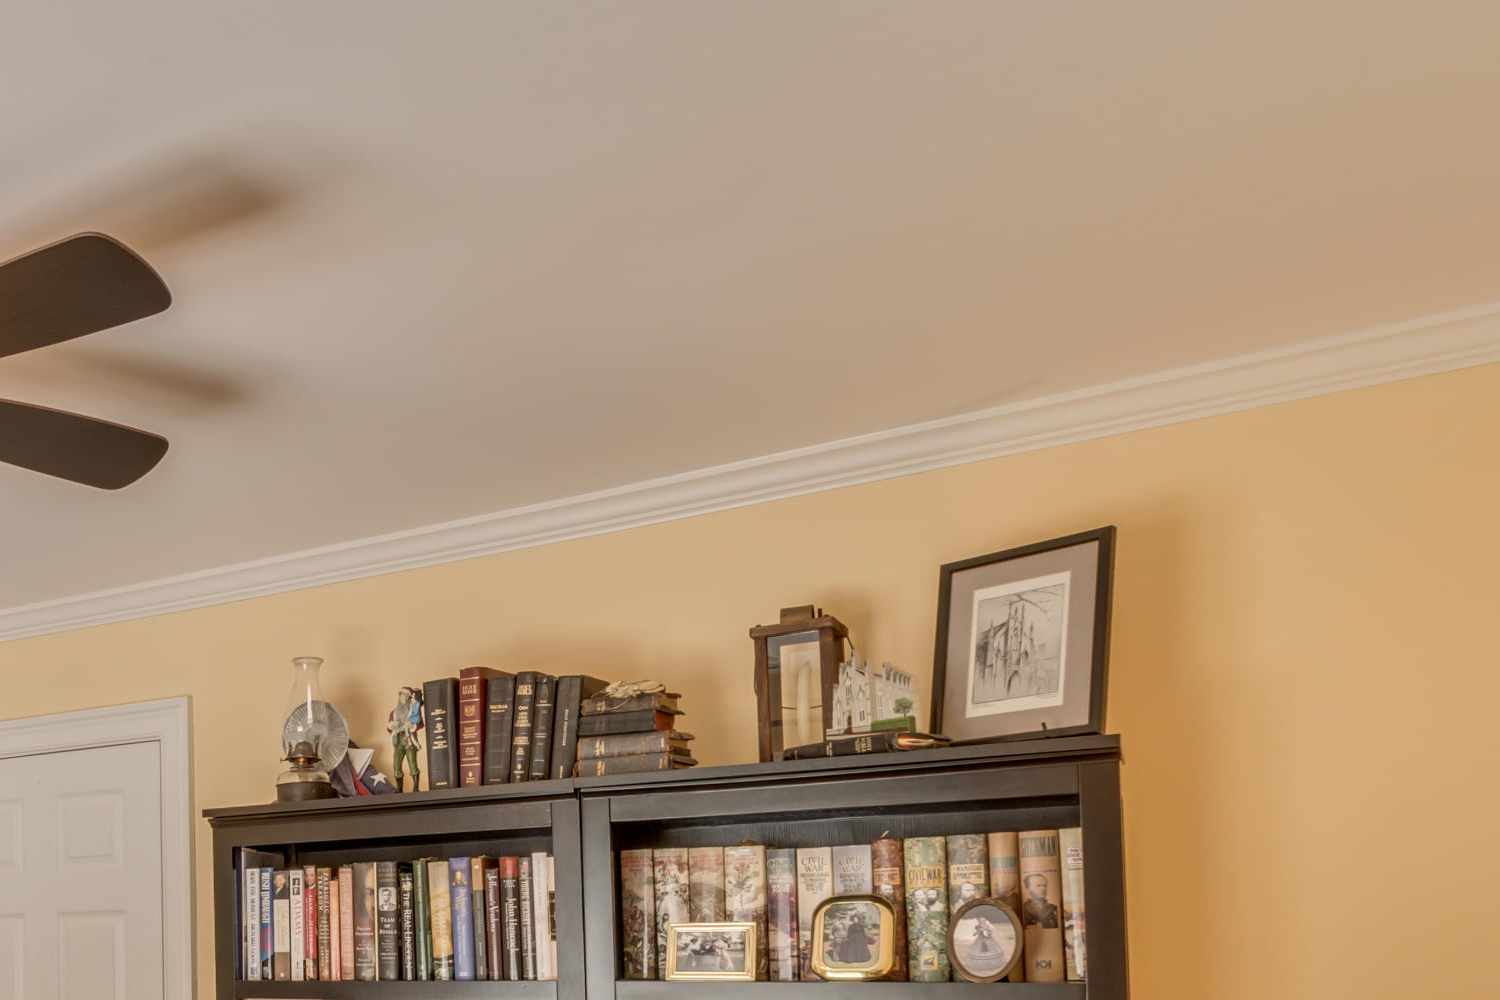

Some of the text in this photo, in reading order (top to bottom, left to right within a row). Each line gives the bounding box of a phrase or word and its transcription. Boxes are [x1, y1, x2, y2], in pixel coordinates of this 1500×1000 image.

[294, 899, 302, 936] ADAMS
[403, 909, 412, 931] REAL
[505, 898, 519, 953] John Hancock
[404, 931, 413, 970] LINCOLN
